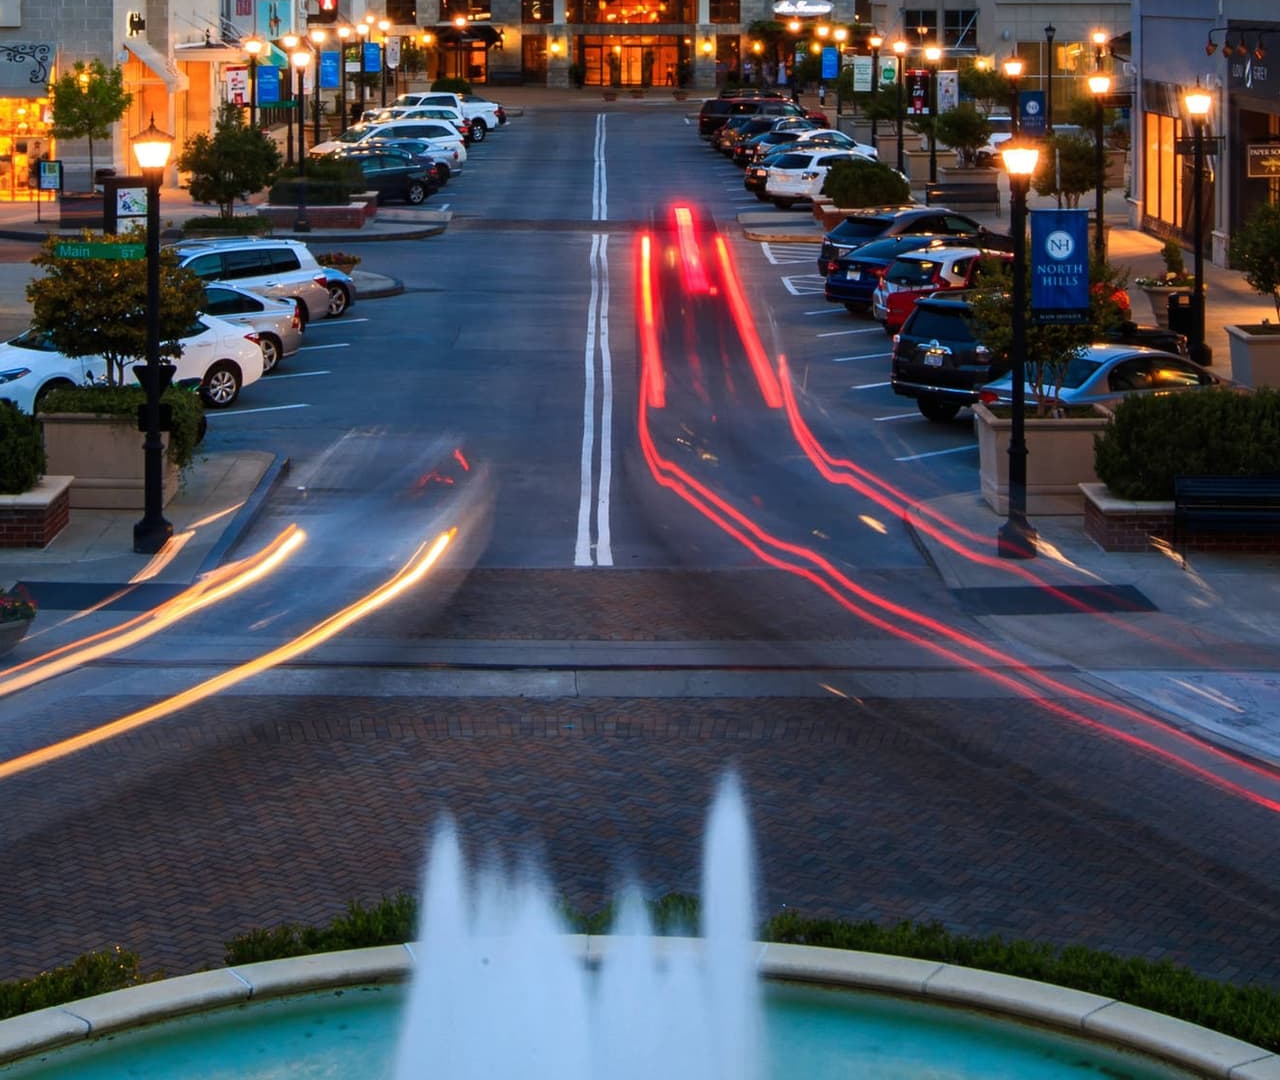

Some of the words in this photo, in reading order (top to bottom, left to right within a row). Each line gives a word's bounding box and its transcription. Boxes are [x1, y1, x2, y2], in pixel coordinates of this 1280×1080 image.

[59, 245, 90, 257] Main
[121, 249, 136, 258] ST
[1037, 263, 1083, 275] NORTH
[1042, 276, 1078, 287] HILLS
